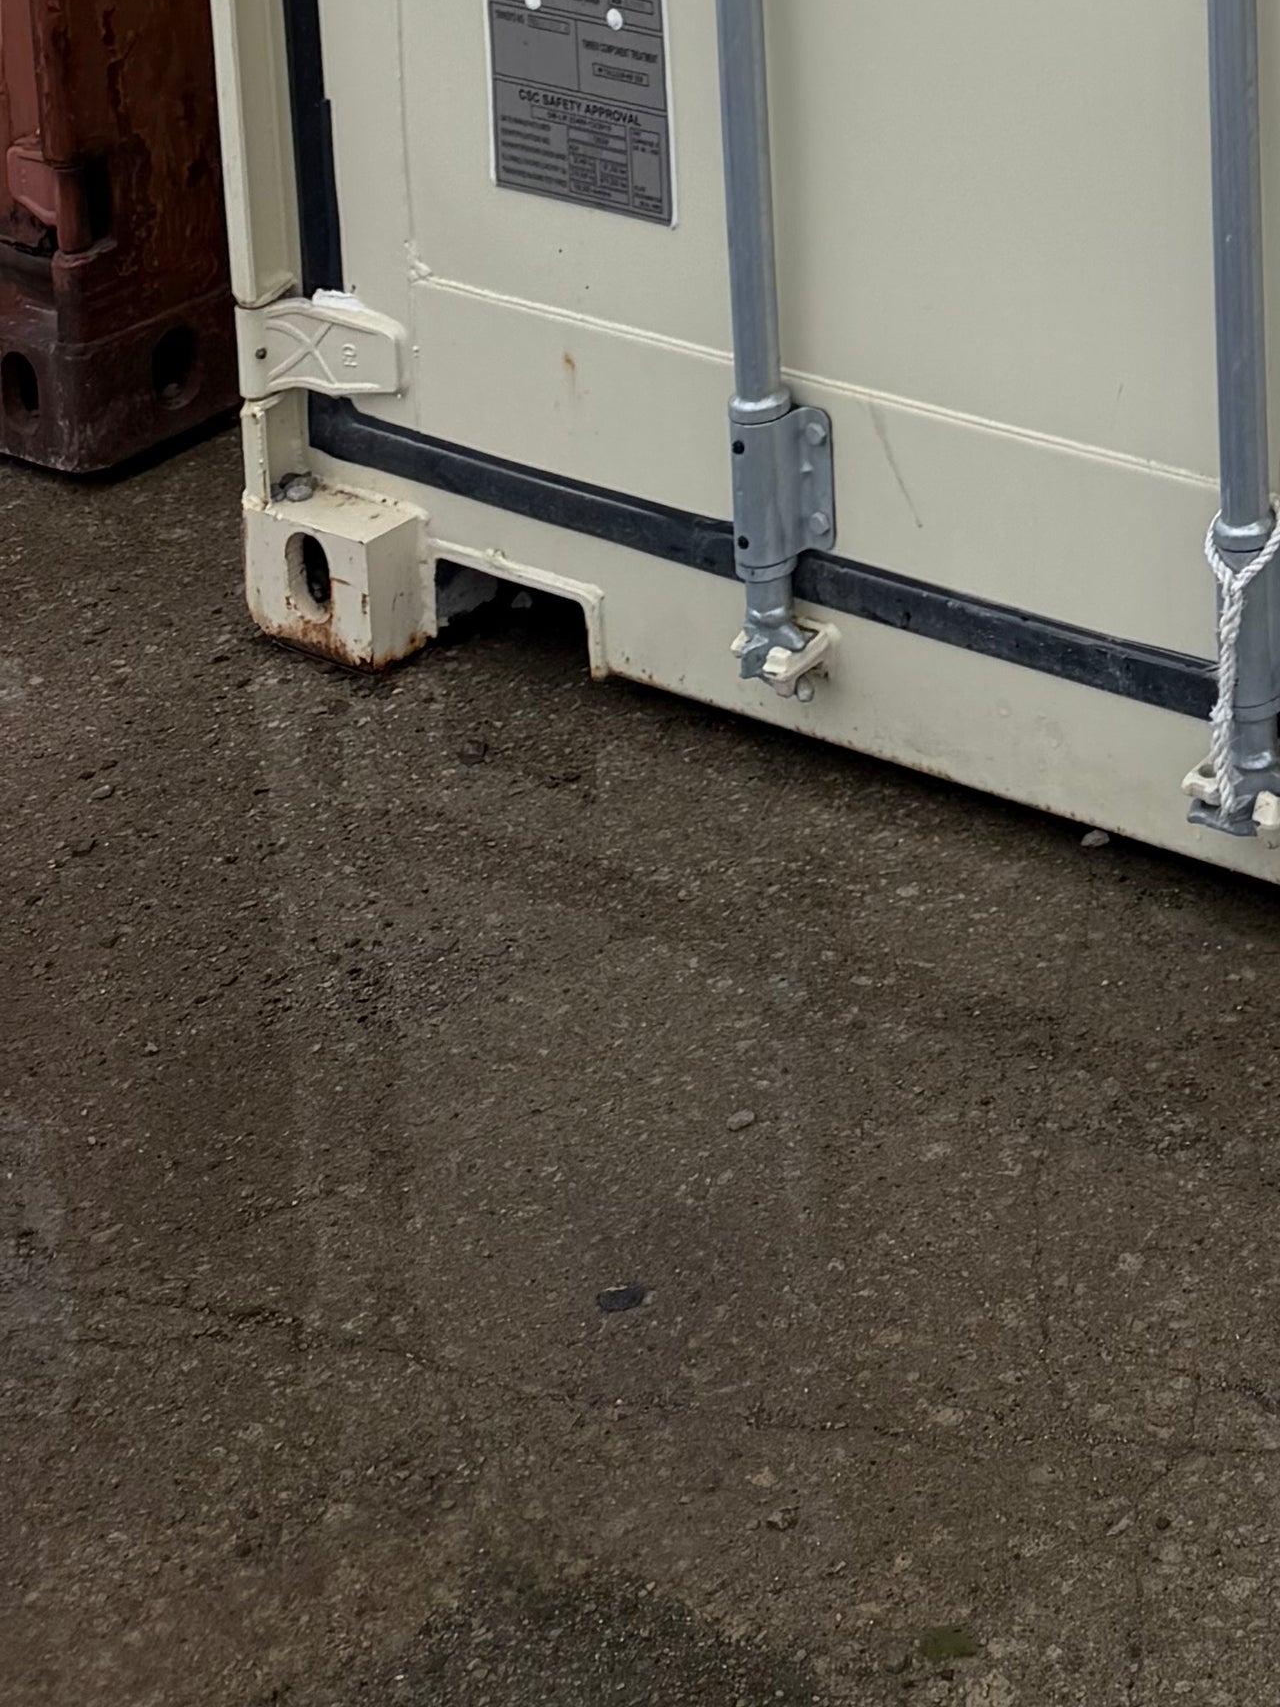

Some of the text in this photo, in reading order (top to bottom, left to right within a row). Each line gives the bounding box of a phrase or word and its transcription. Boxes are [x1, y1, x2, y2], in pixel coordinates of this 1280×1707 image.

[518, 89, 541, 103] CSC
[542, 94, 582, 111] SAFETY
[584, 104, 642, 127] APPROVAL
